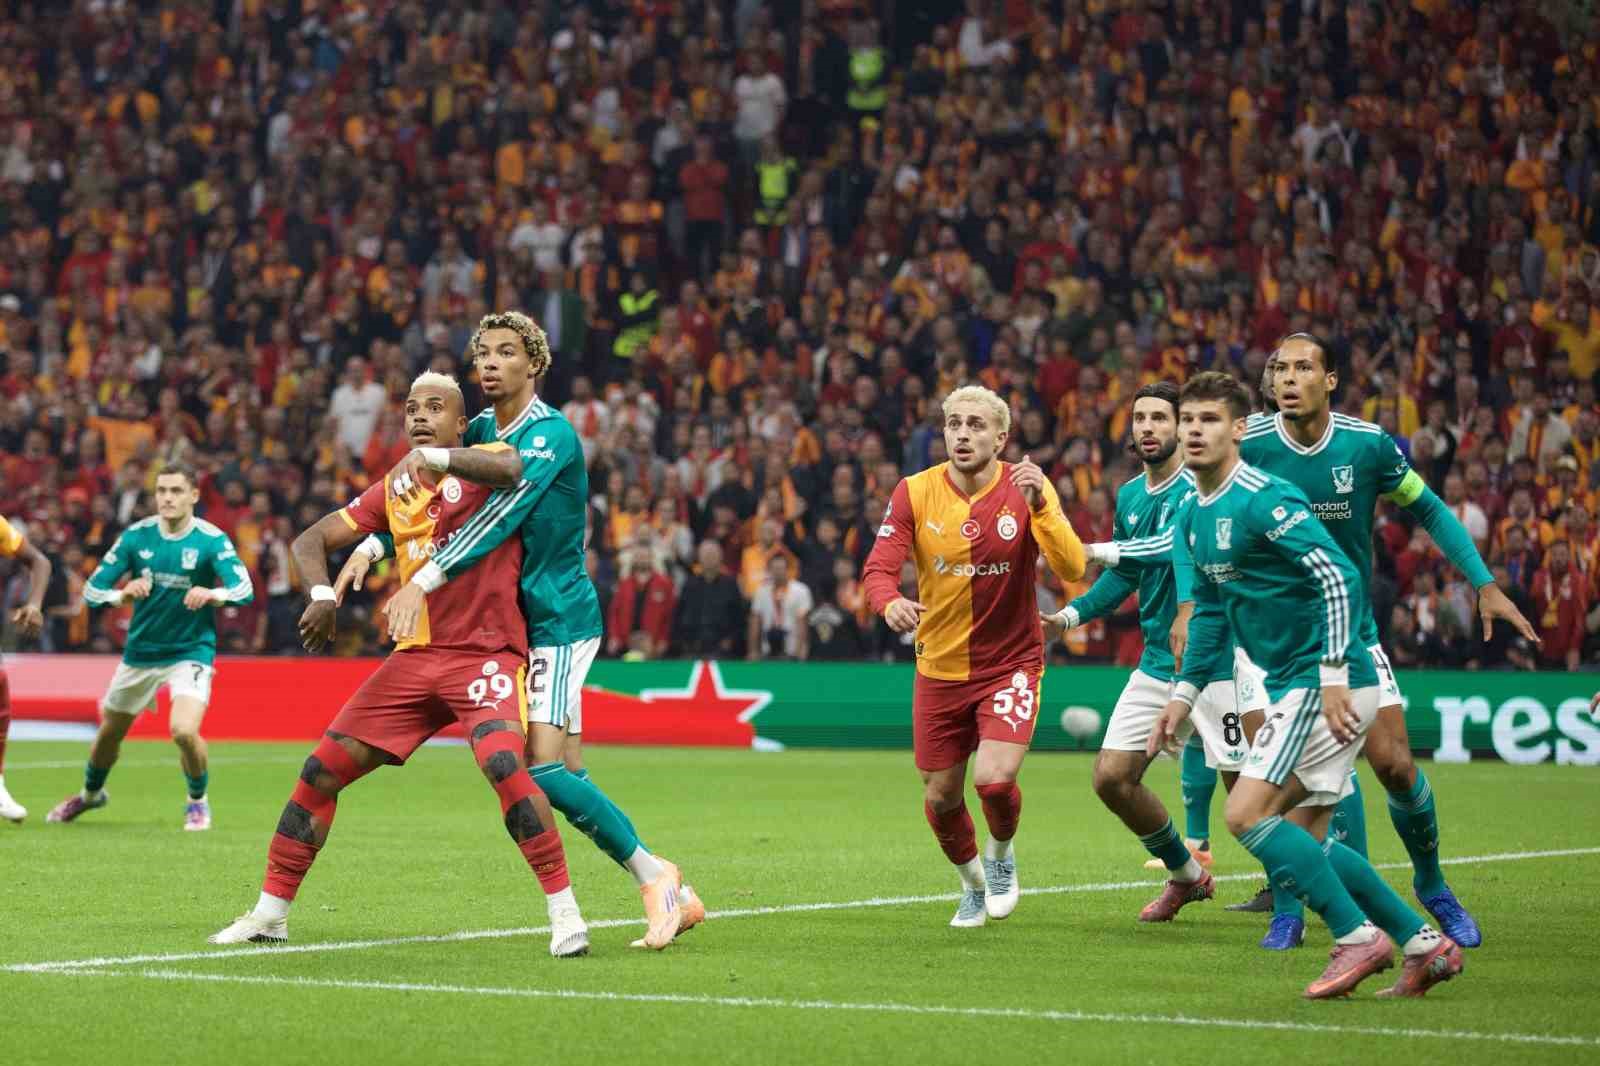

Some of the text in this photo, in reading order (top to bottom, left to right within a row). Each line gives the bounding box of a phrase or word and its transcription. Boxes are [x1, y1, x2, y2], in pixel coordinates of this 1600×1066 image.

[1310, 500, 1349, 511] ndard
[1313, 509, 1352, 520] rtered
[953, 561, 1010, 577] SOCAR
[191, 663, 204, 681] 7
[467, 673, 513, 706] 99
[993, 687, 1034, 721] 53
[1222, 712, 1242, 746] 8
